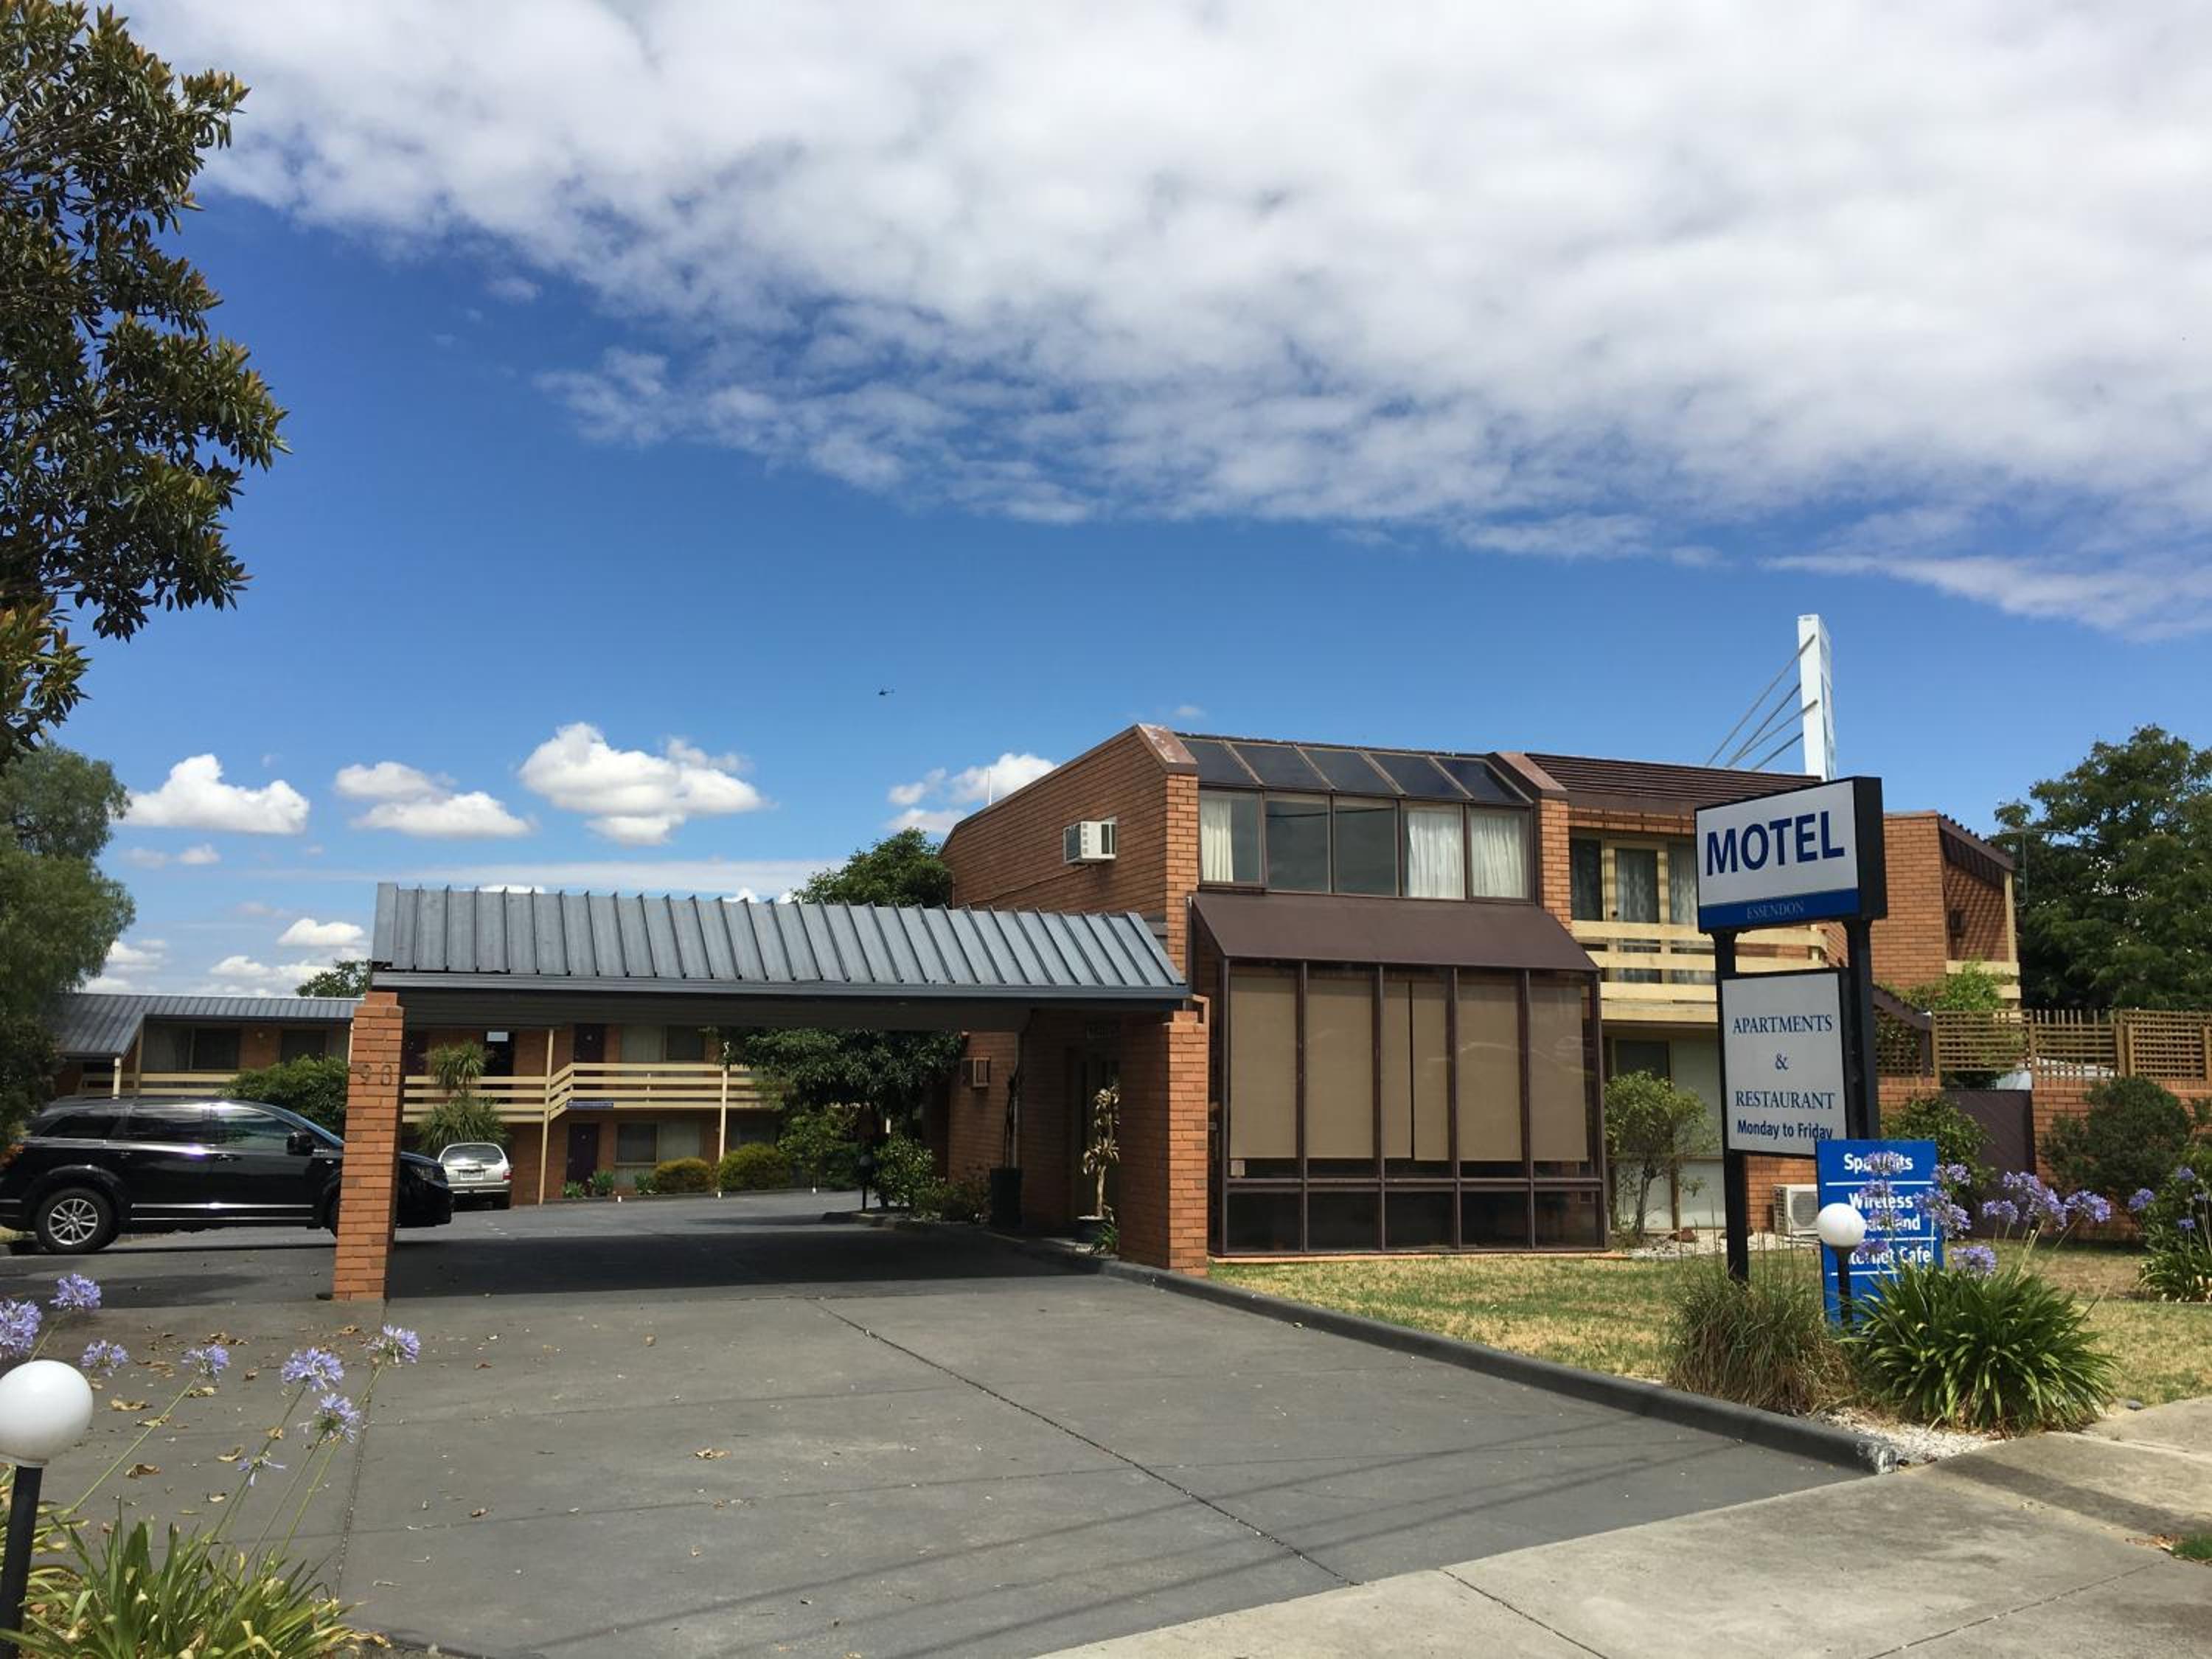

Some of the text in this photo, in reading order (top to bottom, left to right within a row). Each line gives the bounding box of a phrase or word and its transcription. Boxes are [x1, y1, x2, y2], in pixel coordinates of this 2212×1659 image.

[1707, 811, 1845, 876] MOTEL
[1747, 900, 1804, 919] ESSENDON
[1733, 1015, 1832, 1033] APARTMENTS
[1775, 1053, 1788, 1070] &
[1735, 1091, 1834, 1109] RESTAURANT
[1738, 1120, 1832, 1140] Monday to Friday
[1848, 1192, 1913, 1209] Wireless
